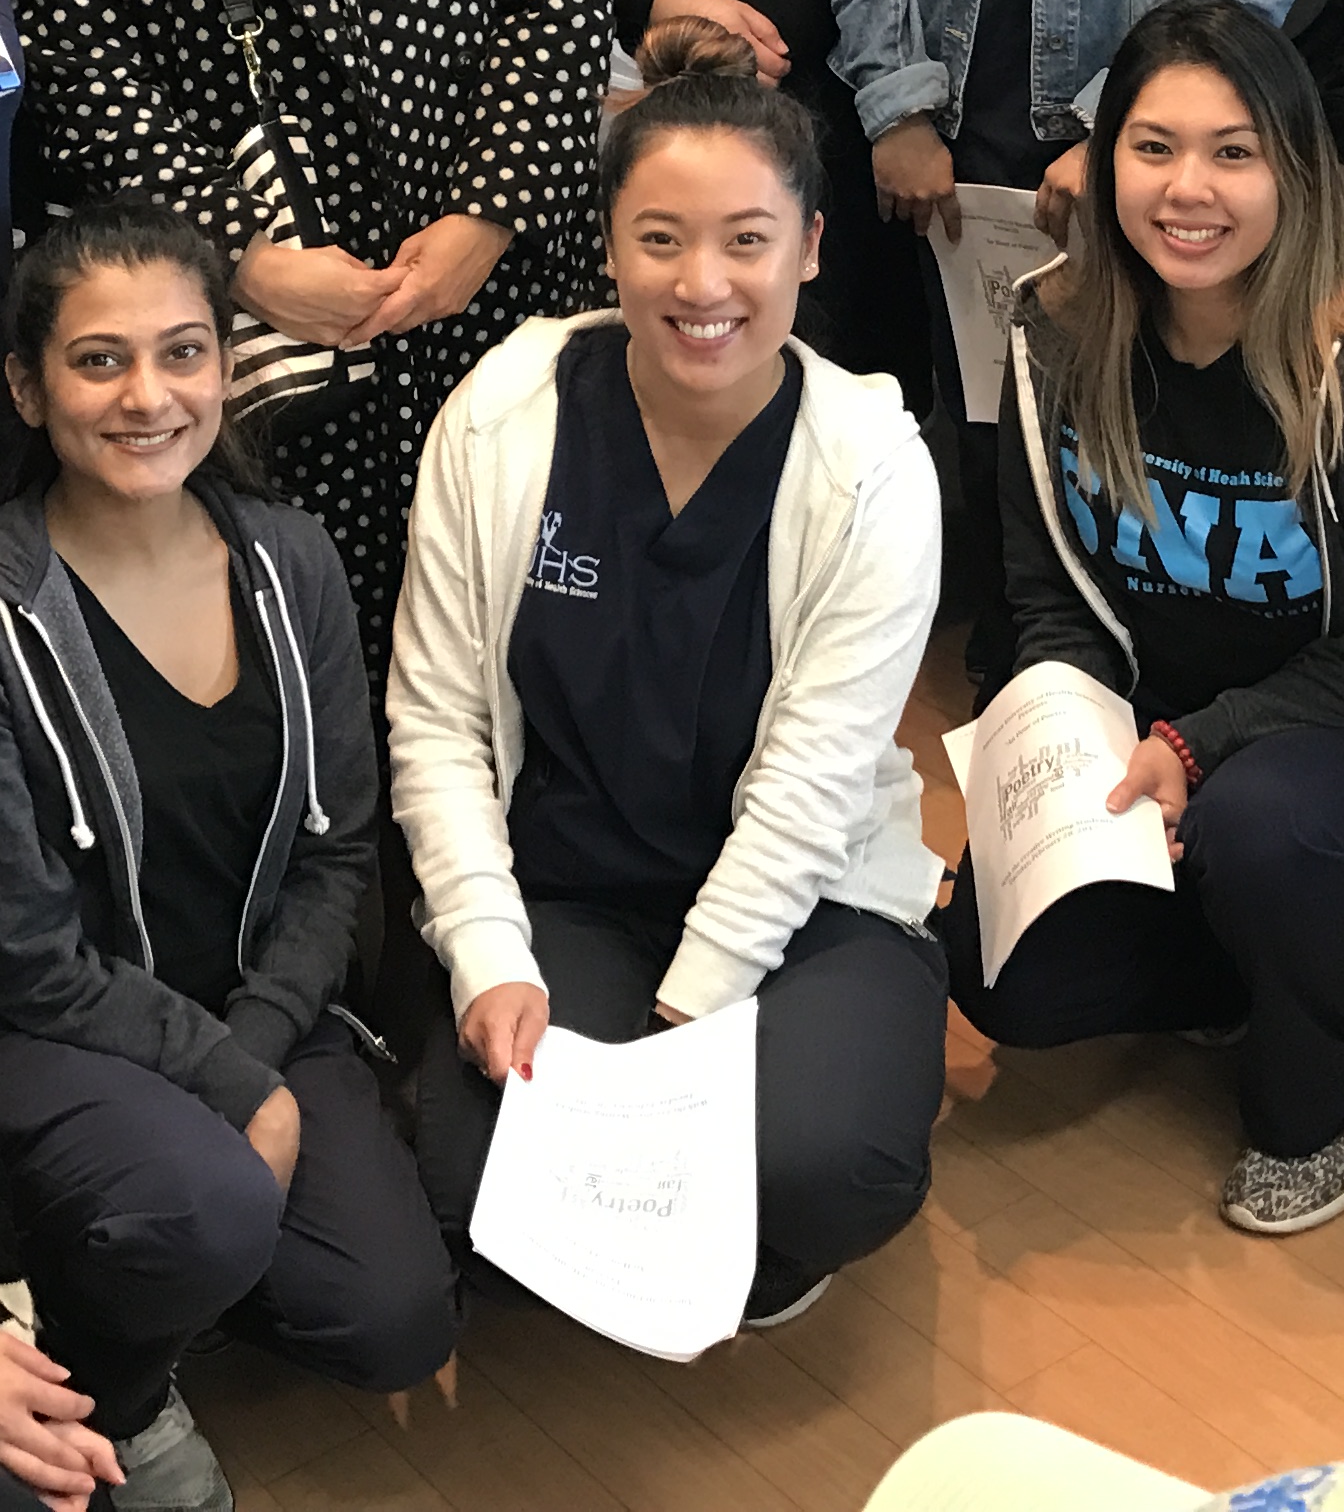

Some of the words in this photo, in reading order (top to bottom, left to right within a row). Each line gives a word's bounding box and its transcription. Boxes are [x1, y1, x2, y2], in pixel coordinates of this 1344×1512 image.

[1142, 451, 1193, 480] ersity
[1208, 468, 1251, 486] Heah
[1253, 470, 1285, 487] Scie
[527, 544, 601, 587] HS
[591, 1190, 674, 1218] Poetry
